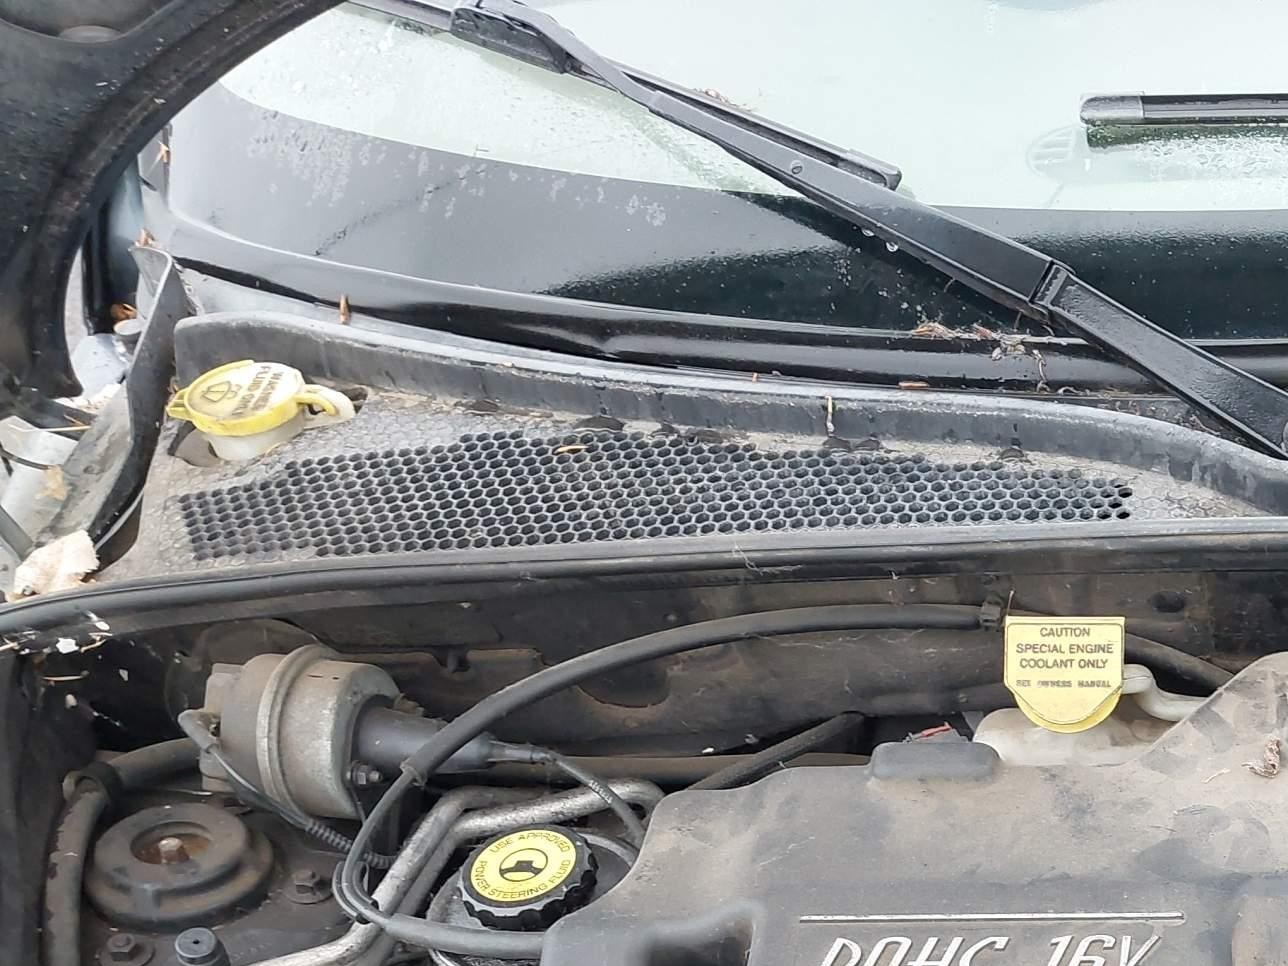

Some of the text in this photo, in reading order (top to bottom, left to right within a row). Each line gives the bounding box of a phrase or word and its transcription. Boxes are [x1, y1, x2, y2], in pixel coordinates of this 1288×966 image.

[1039, 626, 1091, 638] CAUTION
[1015, 643, 1114, 654] SPECIAL ENGINE
[1019, 658, 1109, 669] COOLANT ONLY
[489, 831, 571, 854] USE APPROVED
[474, 859, 572, 899] POWER STEERING FLUID
